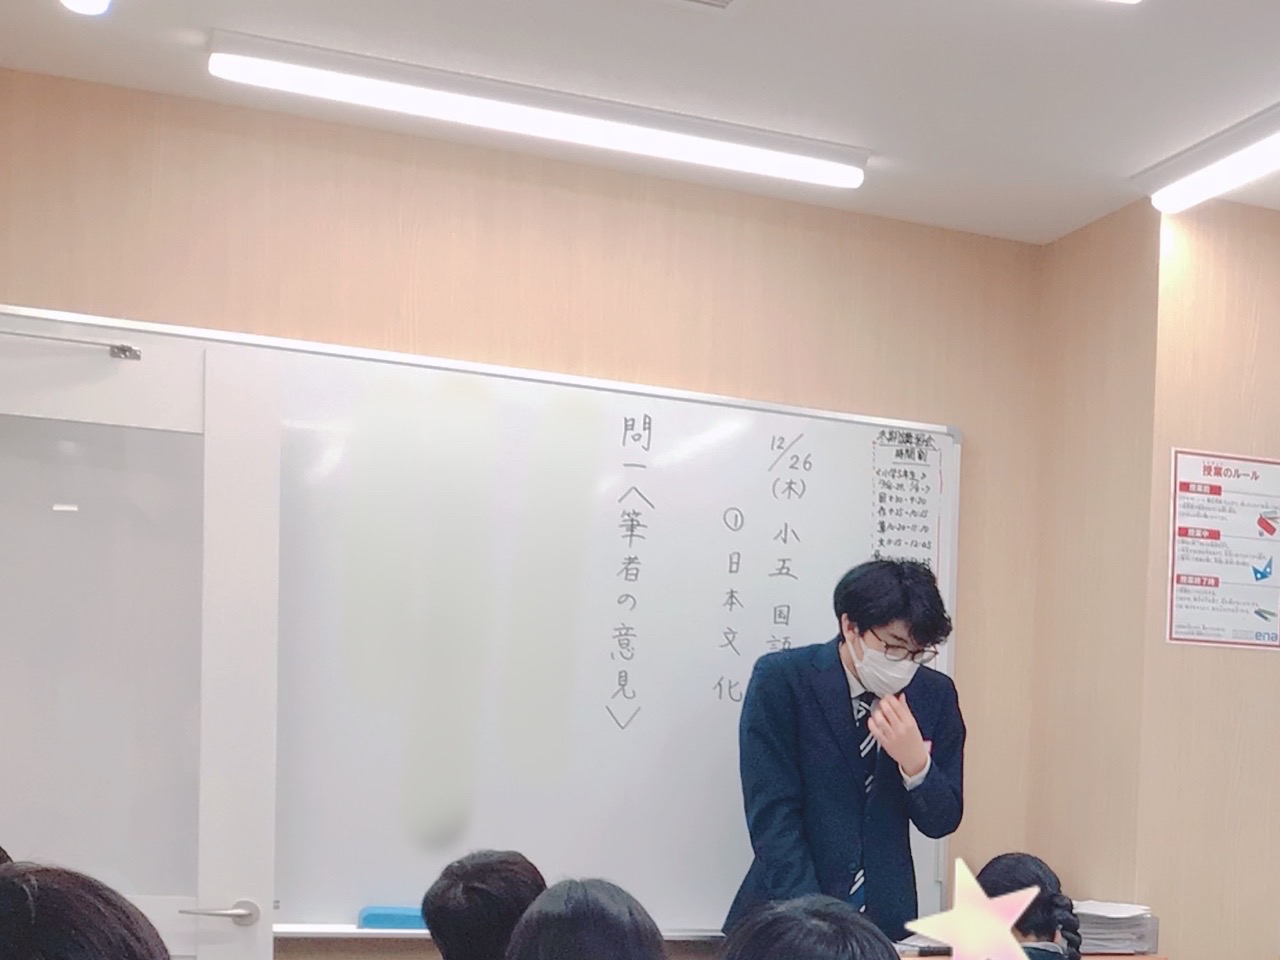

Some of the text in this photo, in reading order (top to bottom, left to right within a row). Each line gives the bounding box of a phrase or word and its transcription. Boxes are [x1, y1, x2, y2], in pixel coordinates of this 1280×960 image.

[1202, 464, 1260, 481] 授業のルール
[1254, 630, 1278, 642] ena
